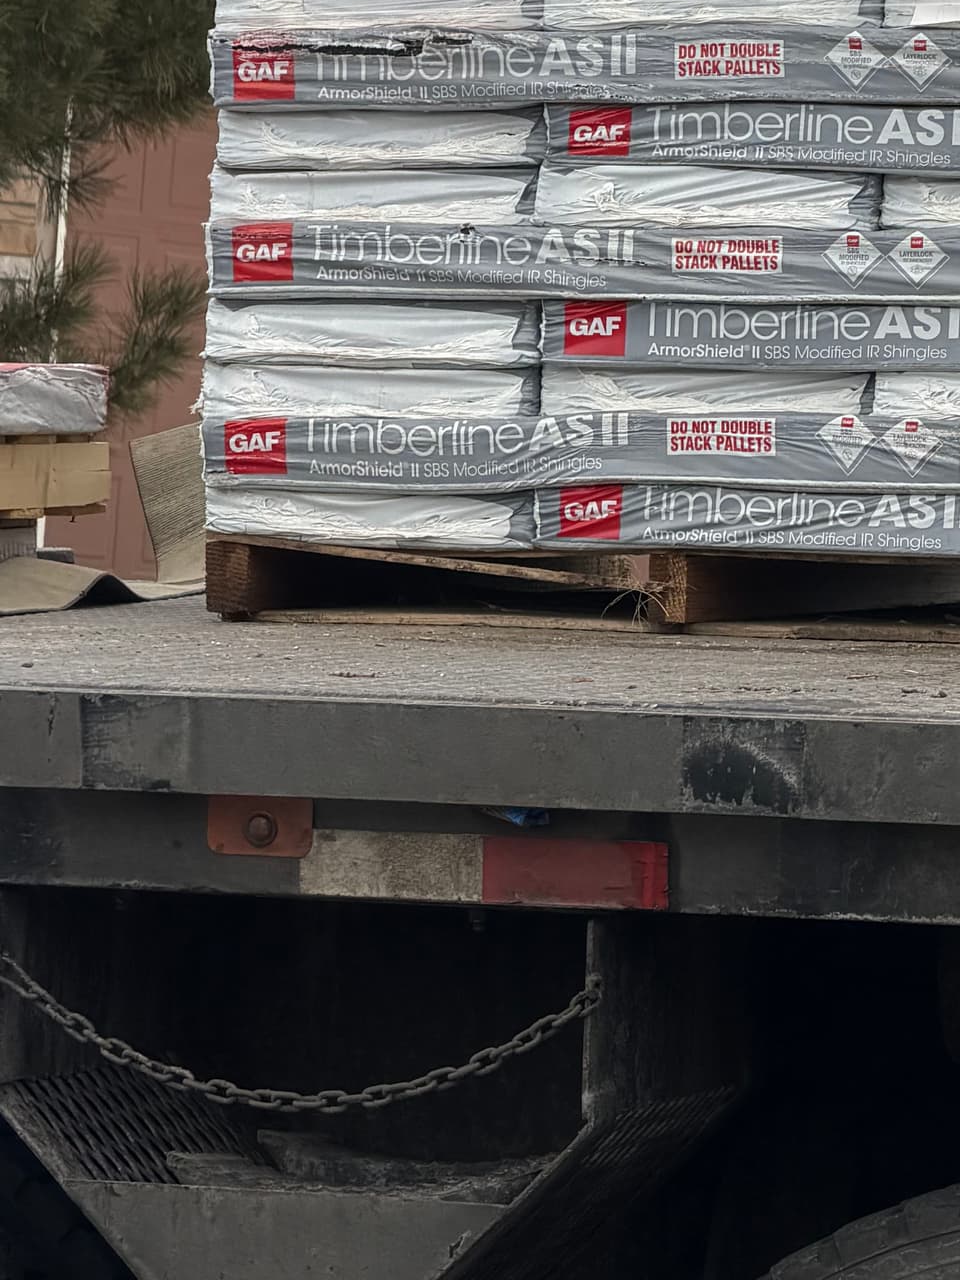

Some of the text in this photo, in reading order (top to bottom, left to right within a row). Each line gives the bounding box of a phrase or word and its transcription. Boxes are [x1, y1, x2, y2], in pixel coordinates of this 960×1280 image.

[679, 42, 780, 59] DO NOT DOUBLE
[237, 62, 288, 81] GAF
[678, 59, 781, 76] STACK PALLETS
[432, 85, 457, 98] SBS
[461, 81, 527, 97] Modified
[530, 82, 540, 95] IR
[574, 124, 625, 142] GAF
[768, 146, 793, 160] SBS
[798, 147, 865, 162] Modified
[870, 150, 883, 163] IR
[887, 150, 951, 165] Shingles
[237, 245, 287, 261] GAF
[676, 240, 779, 254] DO NOT DOUBLE
[675, 255, 778, 271] STACK PALLETS
[430, 269, 453, 282] SBS
[457, 269, 524, 284] Modified
[527, 270, 539, 284] IR
[544, 271, 606, 288] Shingles
[570, 319, 620, 336] GAF
[765, 345, 790, 359] SBS
[795, 345, 862, 359] Modified
[867, 346, 880, 359] IR
[883, 346, 947, 360] Shingles
[671, 421, 772, 434] DO NOT DOUBLE
[230, 432, 280, 452] GAF
[671, 436, 772, 452] STACK PALLETS
[424, 464, 449, 477] SBS
[454, 461, 519, 476] Modified
[540, 455, 601, 471] Shingles
[564, 501, 617, 520] GAF
[759, 532, 785, 544] SBS
[789, 532, 856, 545] Modified
[861, 534, 874, 547] IR
[878, 534, 941, 549] Shingles
